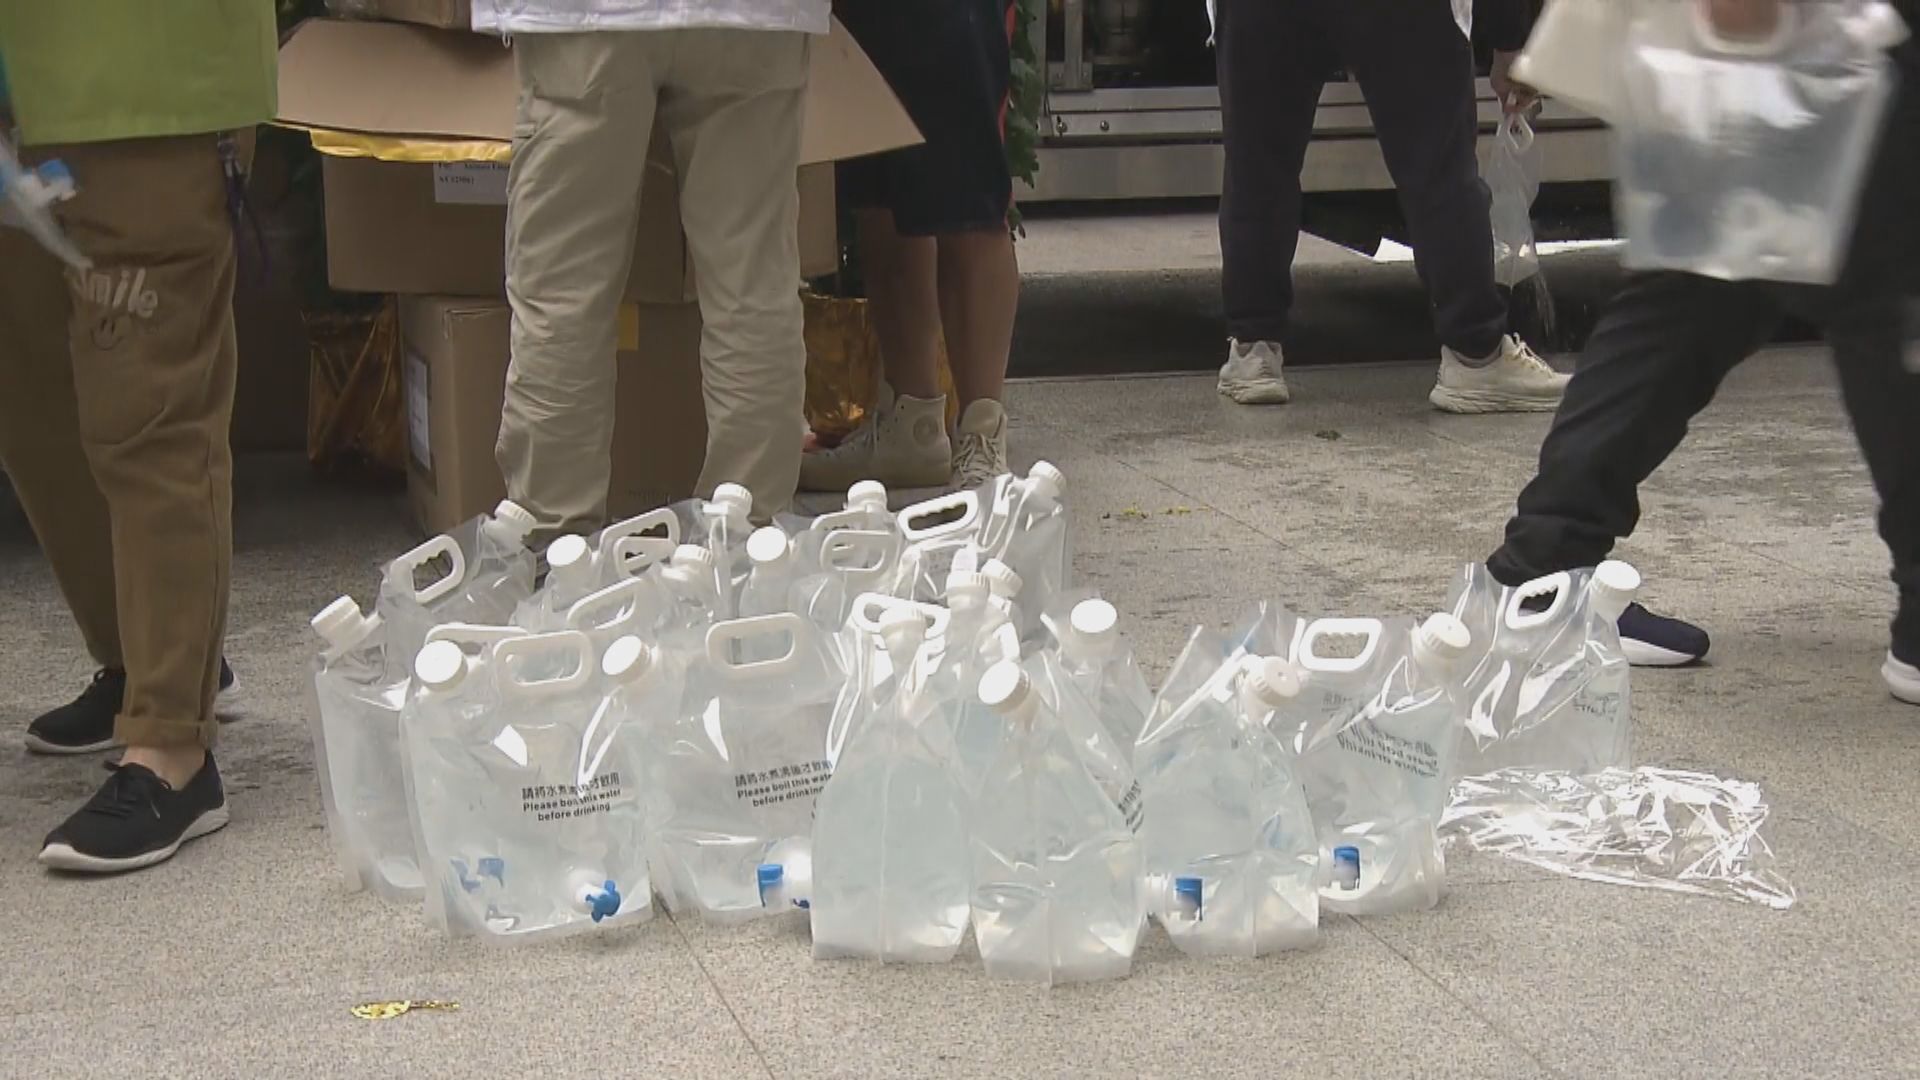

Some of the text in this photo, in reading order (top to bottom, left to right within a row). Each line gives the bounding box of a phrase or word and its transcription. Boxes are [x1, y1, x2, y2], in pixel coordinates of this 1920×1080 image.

[737, 772, 833, 800] Please boil this wate
[523, 801, 558, 813] Please
[599, 788, 621, 800] water
[752, 795, 784, 808] before
[538, 803, 610, 821] before drinking
